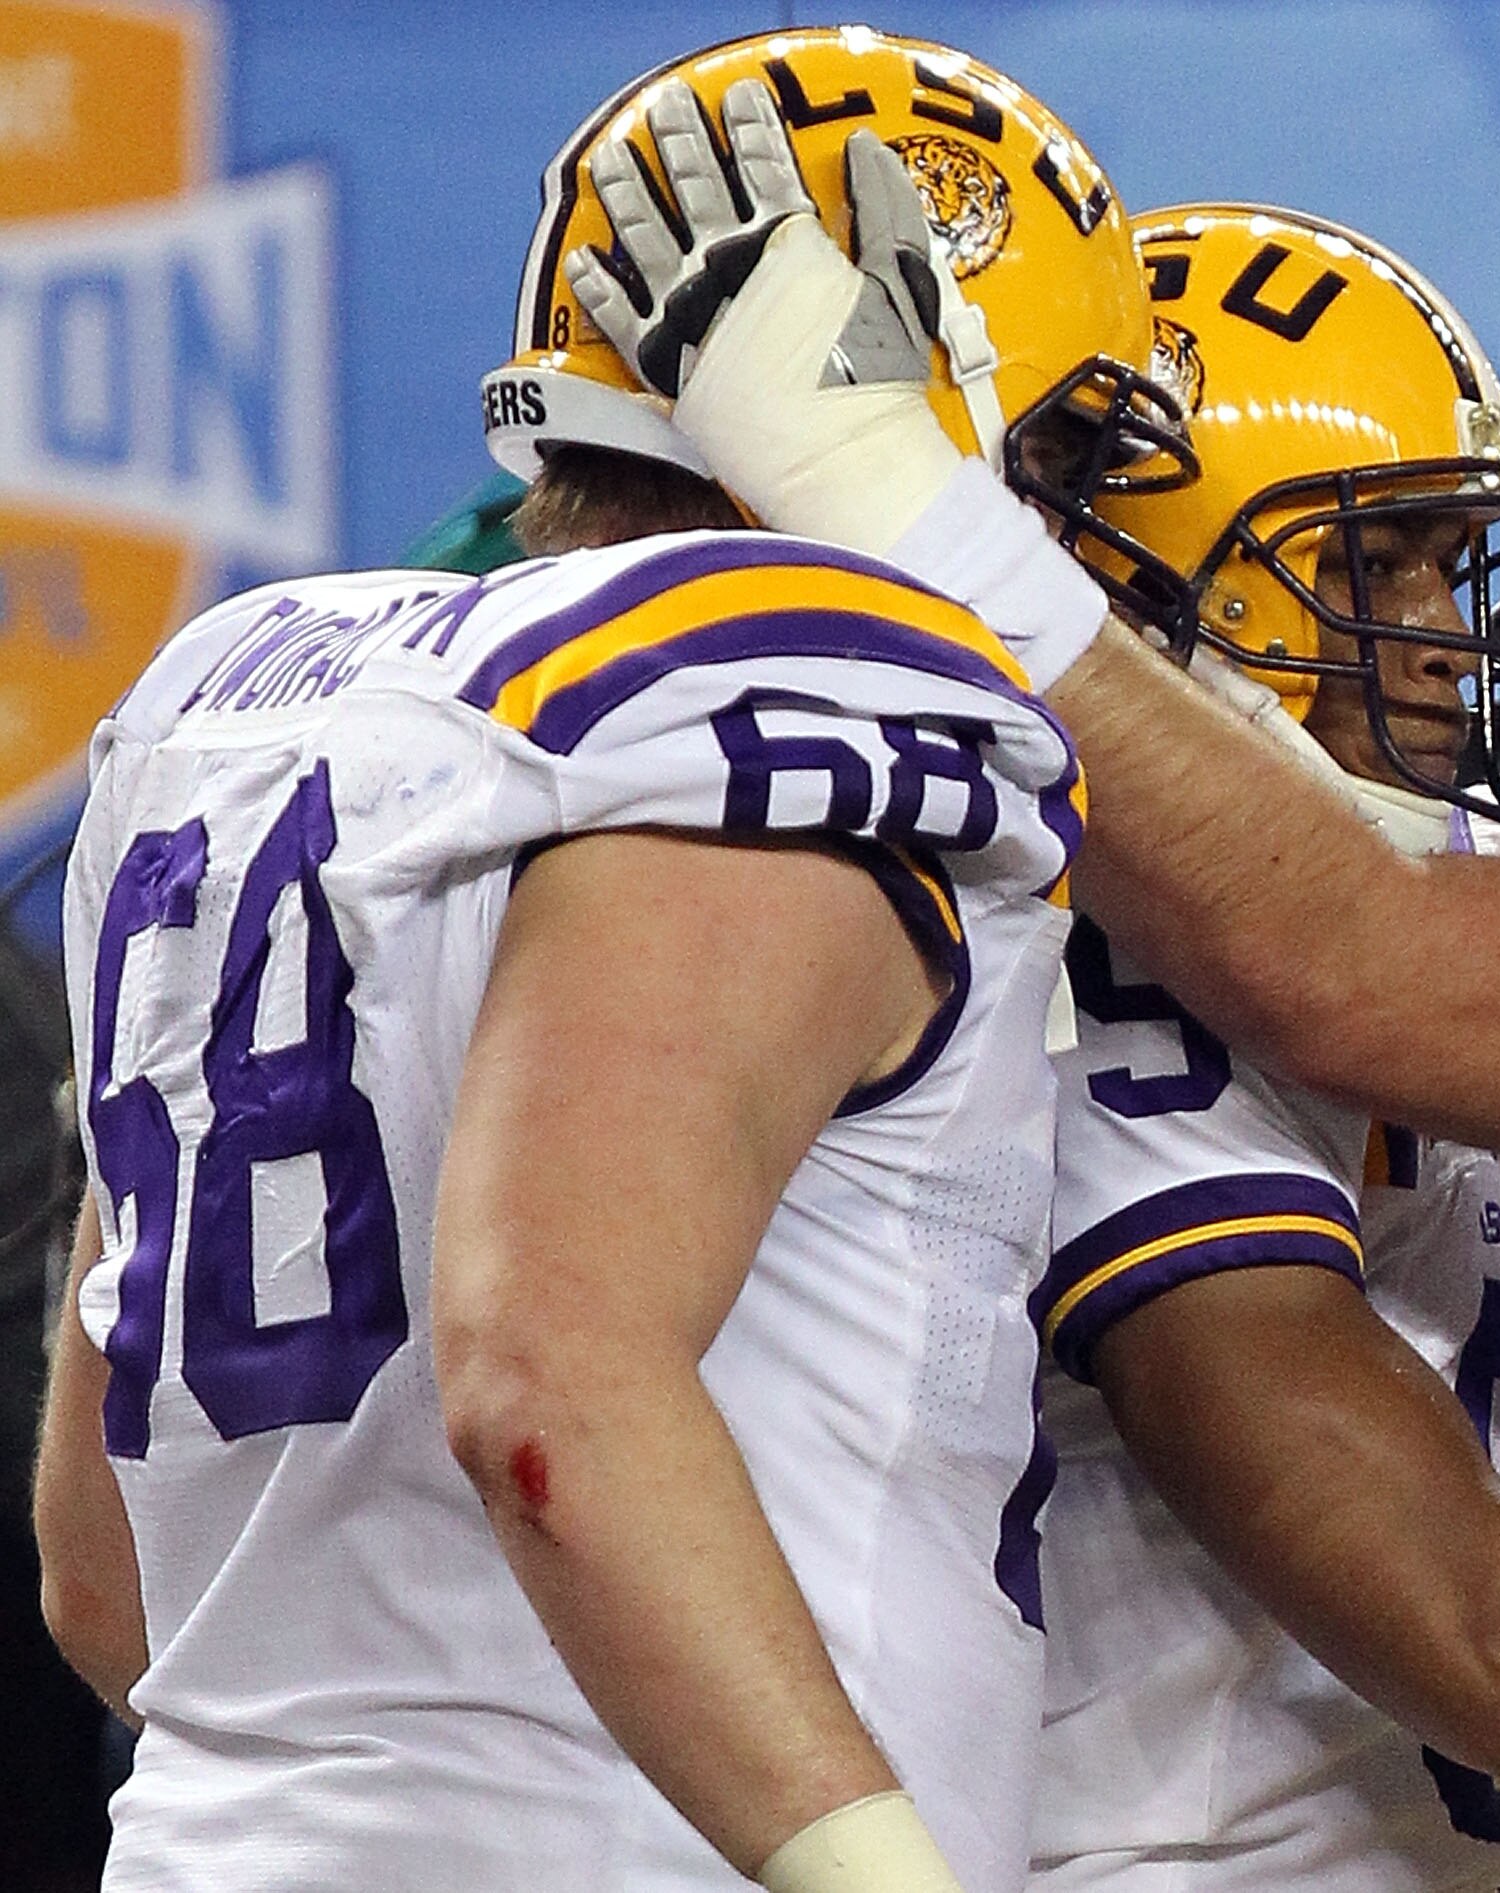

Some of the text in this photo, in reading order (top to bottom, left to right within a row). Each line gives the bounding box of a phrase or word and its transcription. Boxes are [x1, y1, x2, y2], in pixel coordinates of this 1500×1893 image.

[764, 57, 1112, 237] LSU
[0, 222, 287, 512] ON
[484, 380, 547, 434] ERS
[552, 305, 571, 349] 8
[709, 686, 1000, 853] 68
[88, 756, 409, 1459] 68
